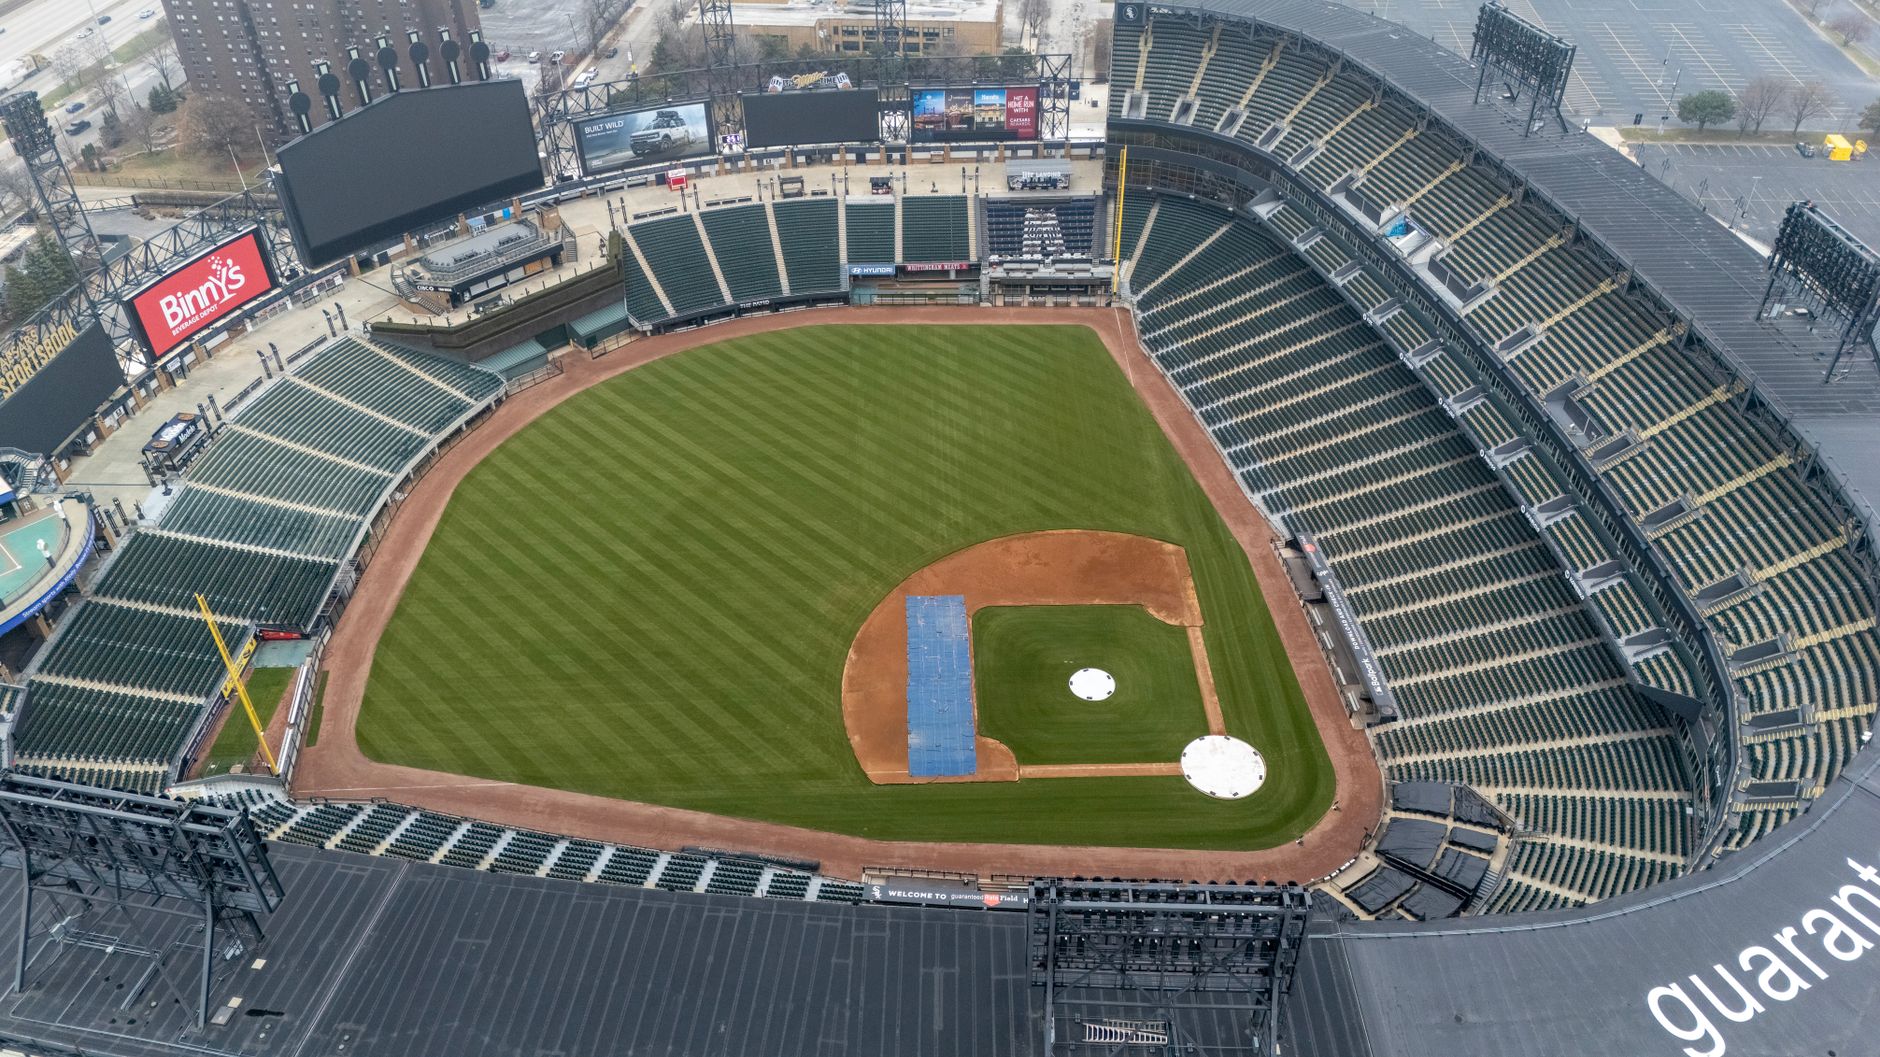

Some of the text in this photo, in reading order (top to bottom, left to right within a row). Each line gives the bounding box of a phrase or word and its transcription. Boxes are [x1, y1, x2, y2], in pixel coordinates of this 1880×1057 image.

[1007, 100, 1035, 108] HOME RUN
[584, 123, 604, 134] BUILT
[605, 120, 625, 130] WILD
[172, 303, 219, 337] BEVERAGE DEPOT
[0, 318, 79, 400] SPORTSBOOK
[22, 603, 42, 618] Stream
[41, 590, 56, 604] sports
[1336, 607, 1345, 619] AND
[1341, 619, 1360, 650] DOWNLOAD
[1361, 657, 1380, 686] Ballpark
[888, 890, 933, 899] WELCOME
